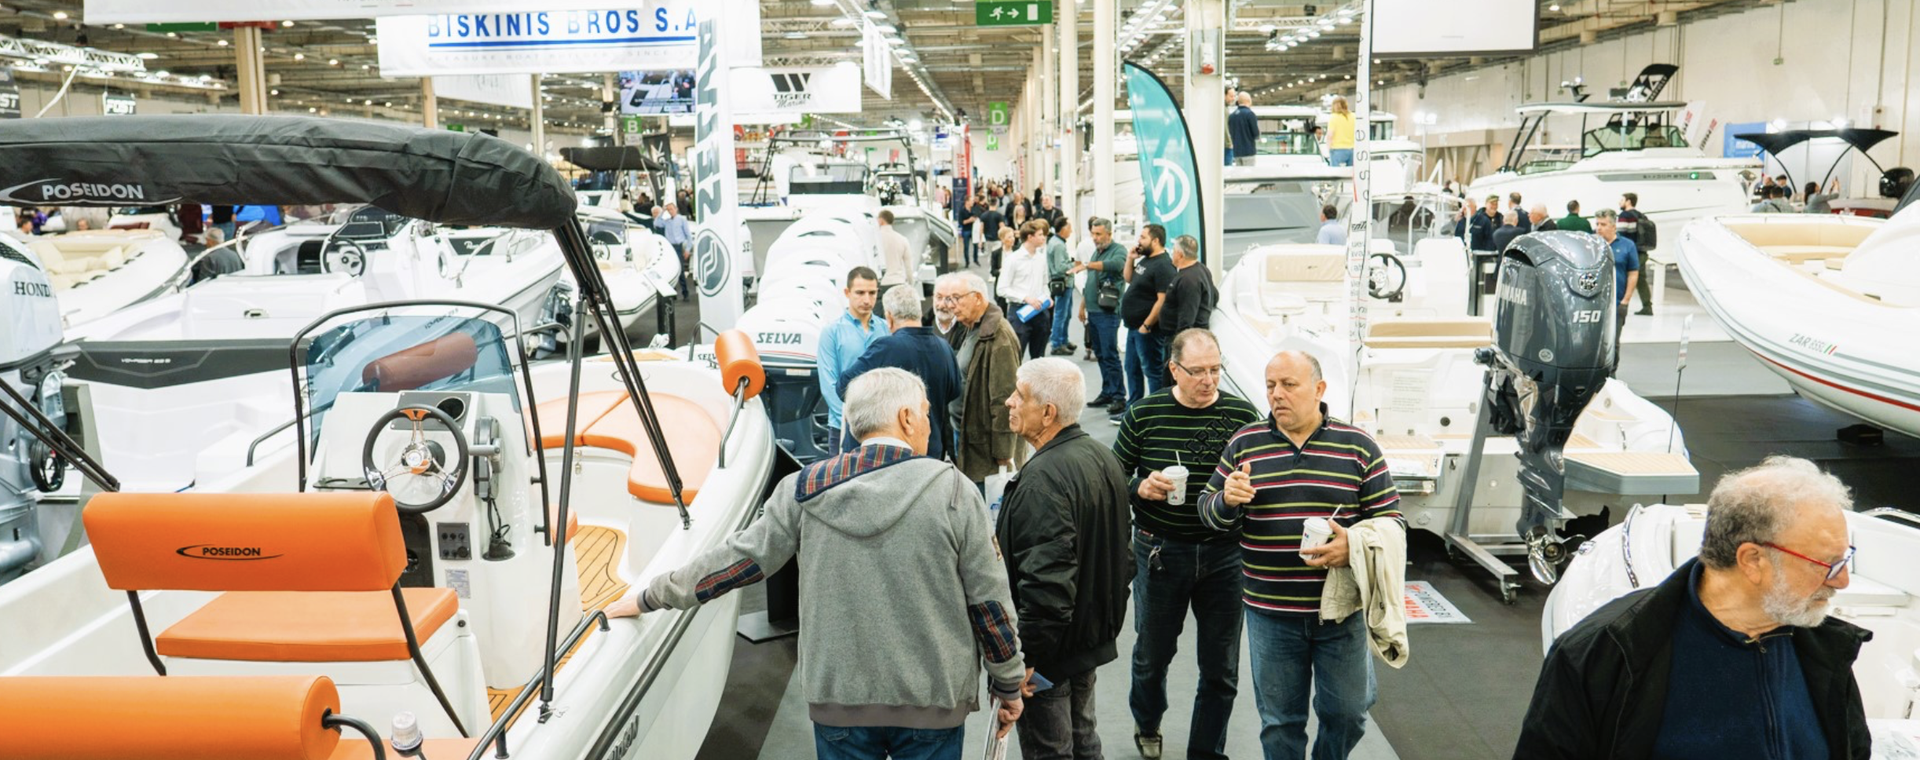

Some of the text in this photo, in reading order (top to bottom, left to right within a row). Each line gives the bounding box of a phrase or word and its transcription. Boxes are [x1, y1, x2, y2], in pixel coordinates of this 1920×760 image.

[428, 12, 550, 37] BISKINIS
[567, 9, 640, 34] BROS
[0, 93, 20, 109] ST
[991, 109, 1006, 125] D
[627, 120, 639, 133] B
[41, 182, 144, 200] POSEIDON
[14, 281, 57, 299] HOND
[1572, 310, 1602, 323] 150
[756, 332, 802, 345] SELVA
[1788, 332, 1812, 348] ZAR
[697, 352, 718, 361] SELV
[202, 547, 262, 557] POSEIDON
